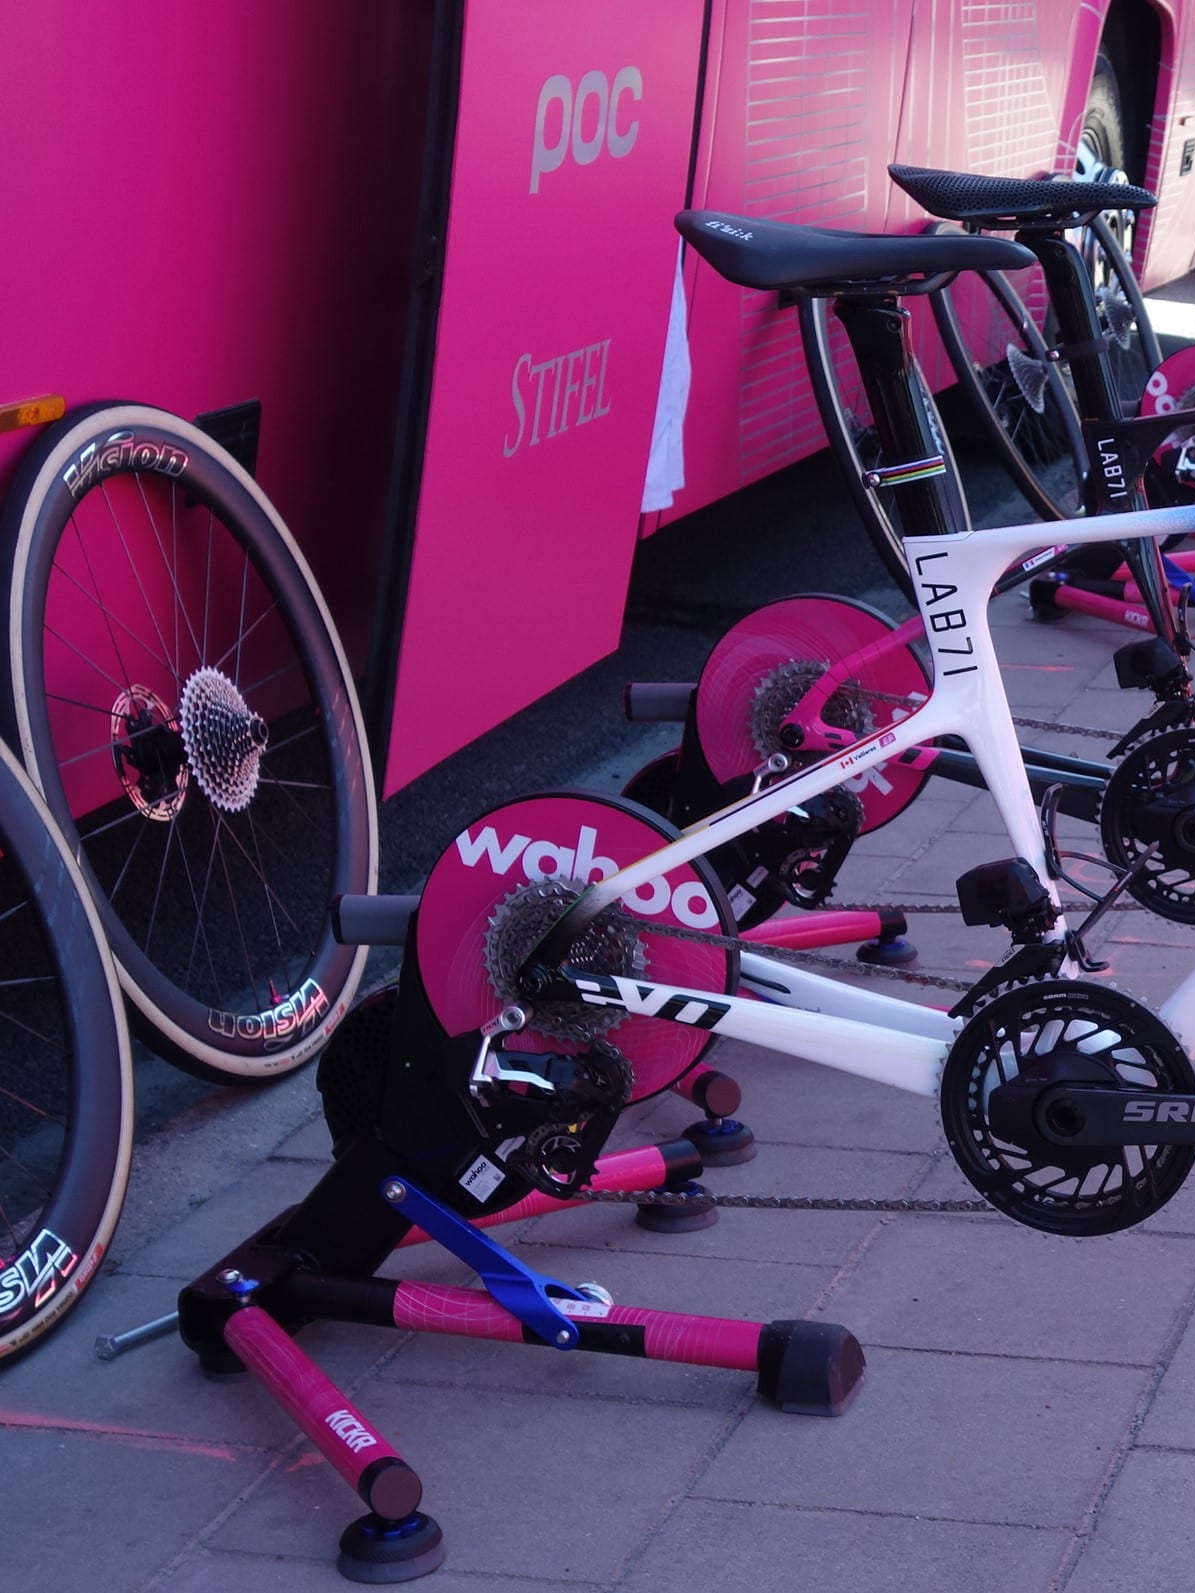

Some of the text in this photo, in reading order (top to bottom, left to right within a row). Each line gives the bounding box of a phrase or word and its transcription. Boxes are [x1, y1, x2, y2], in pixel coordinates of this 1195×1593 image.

[1097, 438, 1128, 498] LAB71
[915, 552, 978, 677] LAB71
[325, 1408, 379, 1453] KICKR
